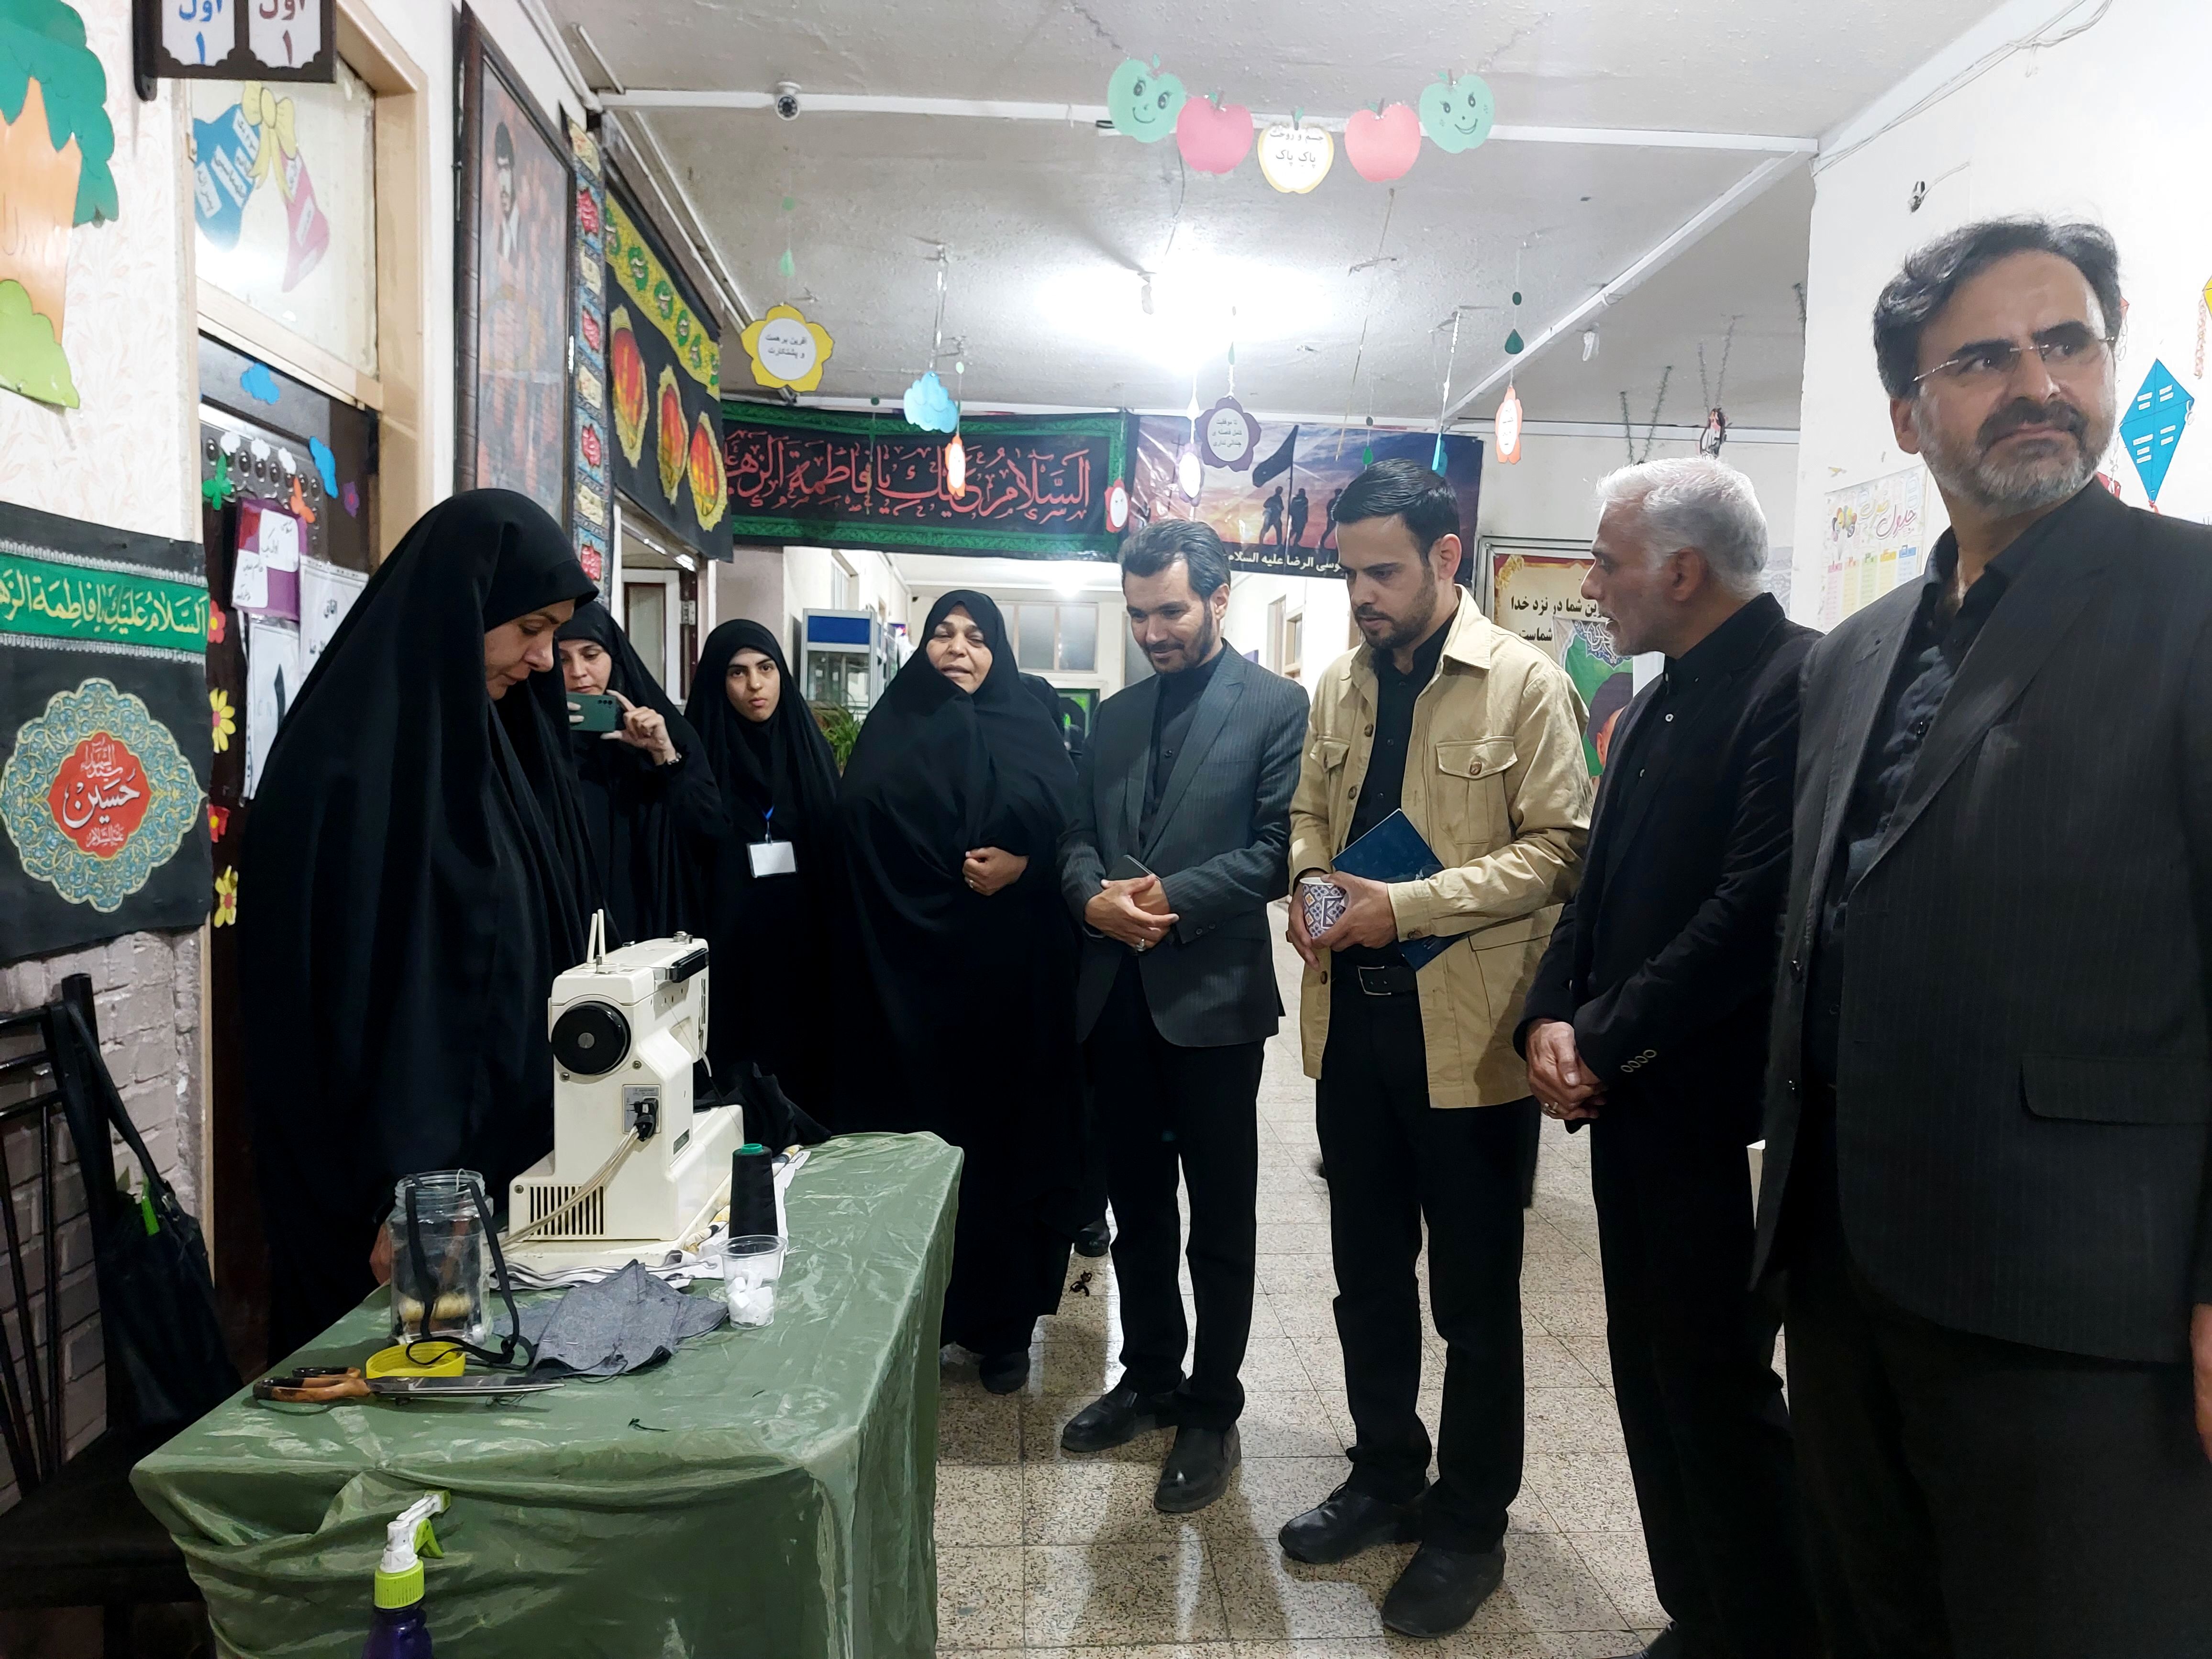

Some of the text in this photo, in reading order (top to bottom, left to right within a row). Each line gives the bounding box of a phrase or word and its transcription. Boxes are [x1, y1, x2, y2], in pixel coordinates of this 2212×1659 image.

[1275, 149, 1294, 166] پاک
[1511, 595, 1529, 611] خدا
[1532, 597, 1548, 616] نزد
[1553, 600, 1562, 615] در
[1566, 598, 1582, 612] شما
